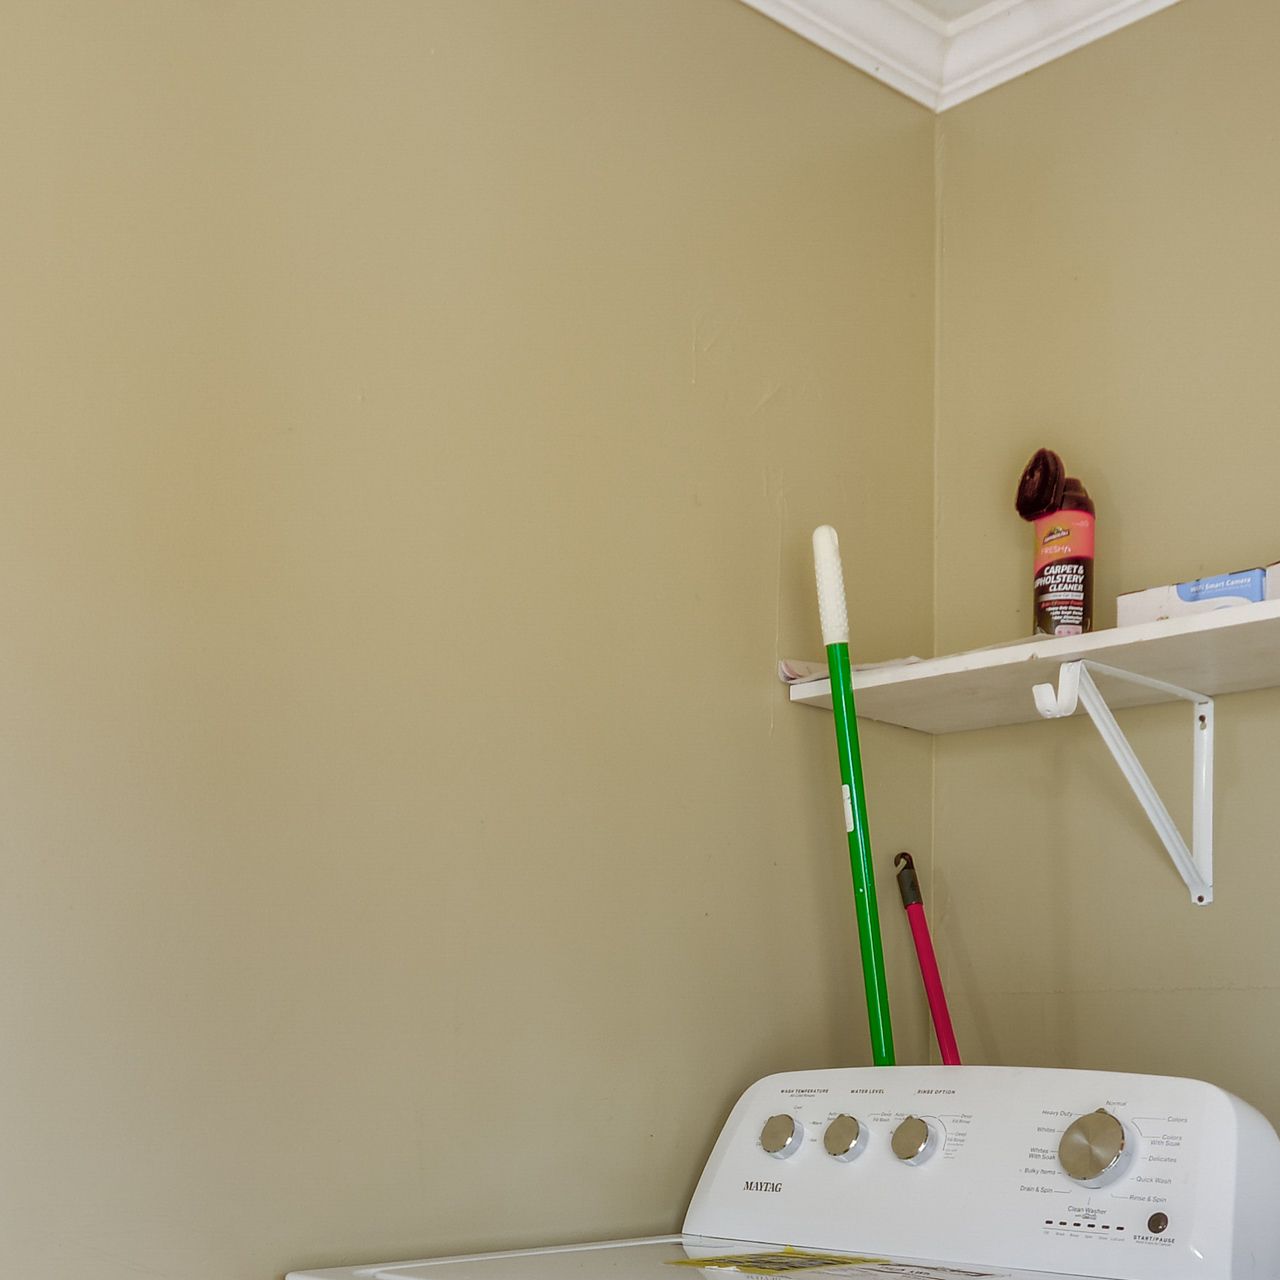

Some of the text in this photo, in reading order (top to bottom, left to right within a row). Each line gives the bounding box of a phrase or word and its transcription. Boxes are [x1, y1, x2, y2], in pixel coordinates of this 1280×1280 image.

[1044, 564, 1084, 575] CARPET &
[1226, 577, 1252, 586] Camera
[1049, 584, 1084, 592] CLEANER
[1060, 1110, 1074, 1118] Duty
[1148, 1155, 1177, 1163] Delicates
[1024, 1167, 1039, 1175] Bulky
[1136, 1175, 1154, 1183] Quick
[743, 1181, 782, 1193] MAYTAG
[1040, 1186, 1053, 1194] Spin
[1152, 1196, 1167, 1204] Spin
[1067, 1205, 1107, 1215] Clean Washer
[1133, 1235, 1175, 1244] START/PAUSE
